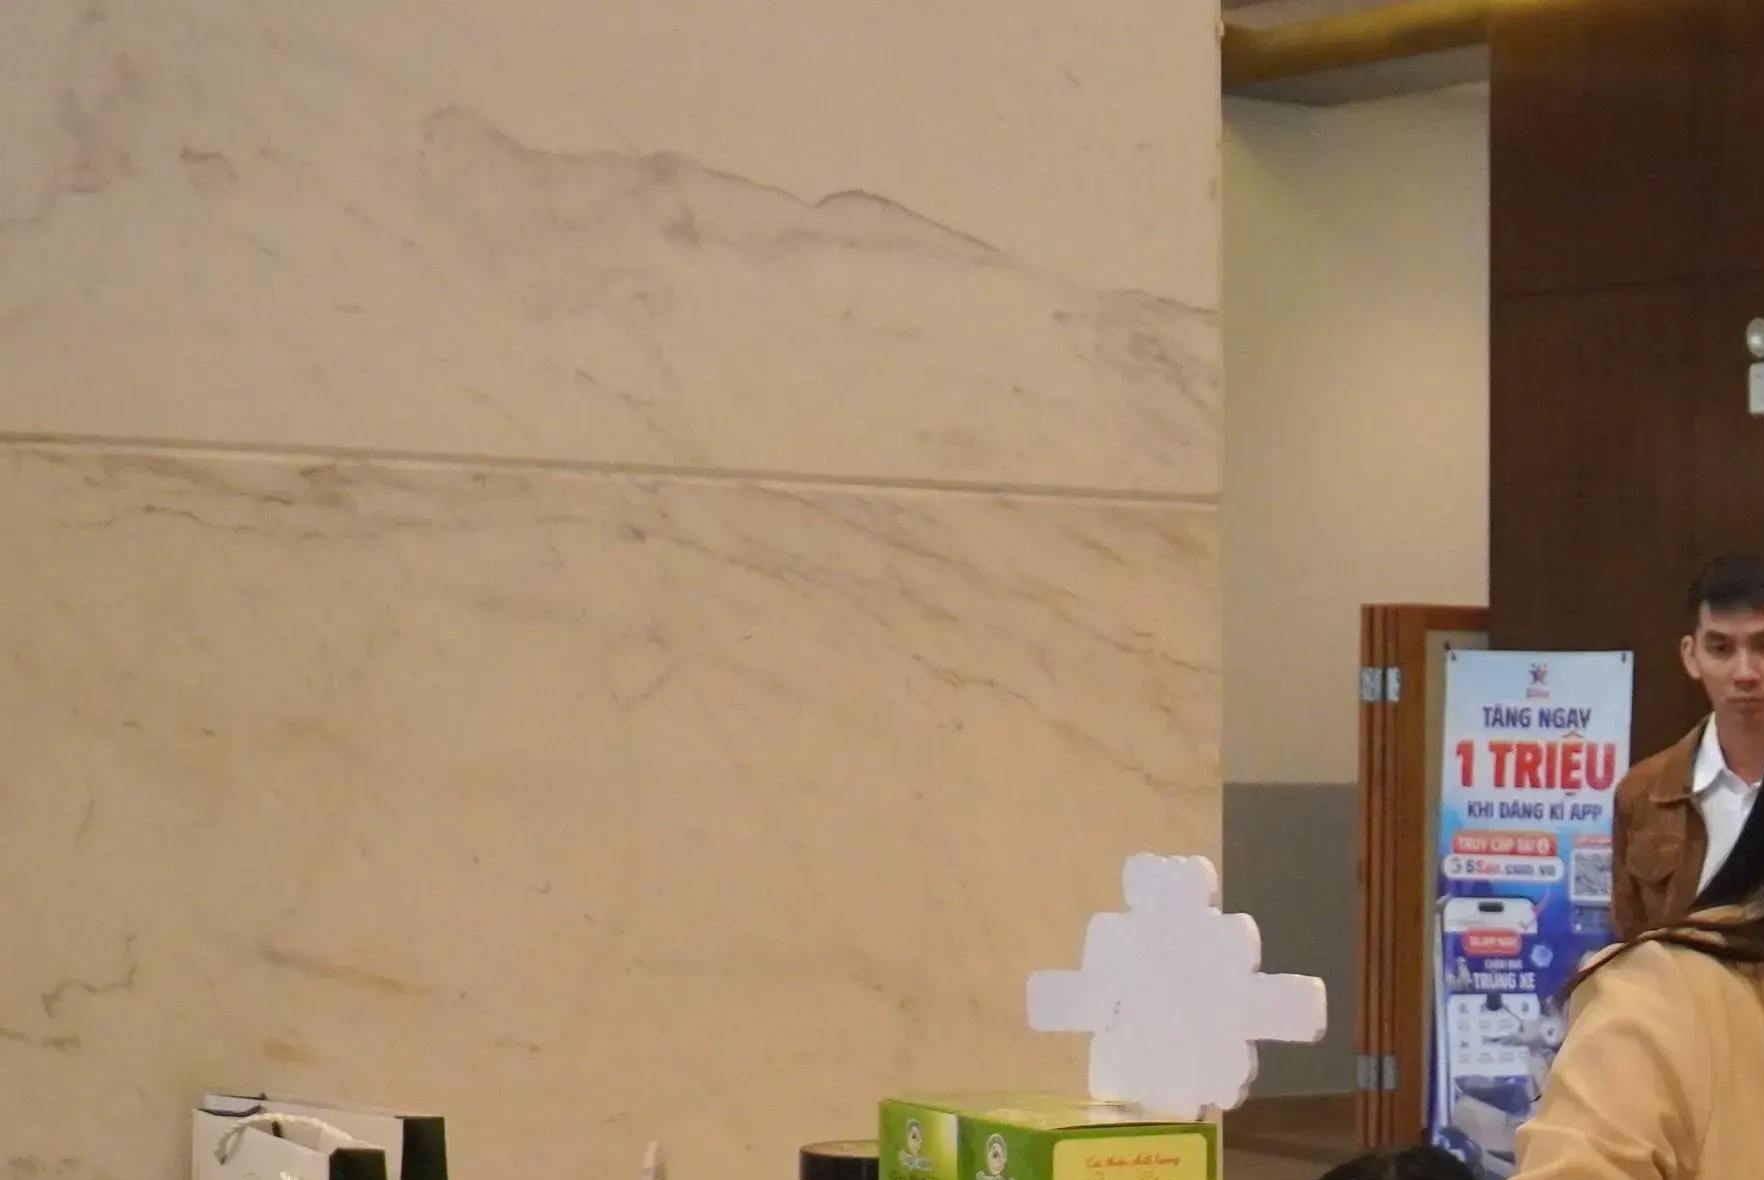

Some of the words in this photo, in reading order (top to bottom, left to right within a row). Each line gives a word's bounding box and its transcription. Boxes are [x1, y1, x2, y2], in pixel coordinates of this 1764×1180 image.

[1538, 706, 1593, 729] NGAY
[1455, 740, 1475, 788] 1
[1488, 730, 1617, 797] TRIỆU
[1467, 799, 1494, 819] KHI
